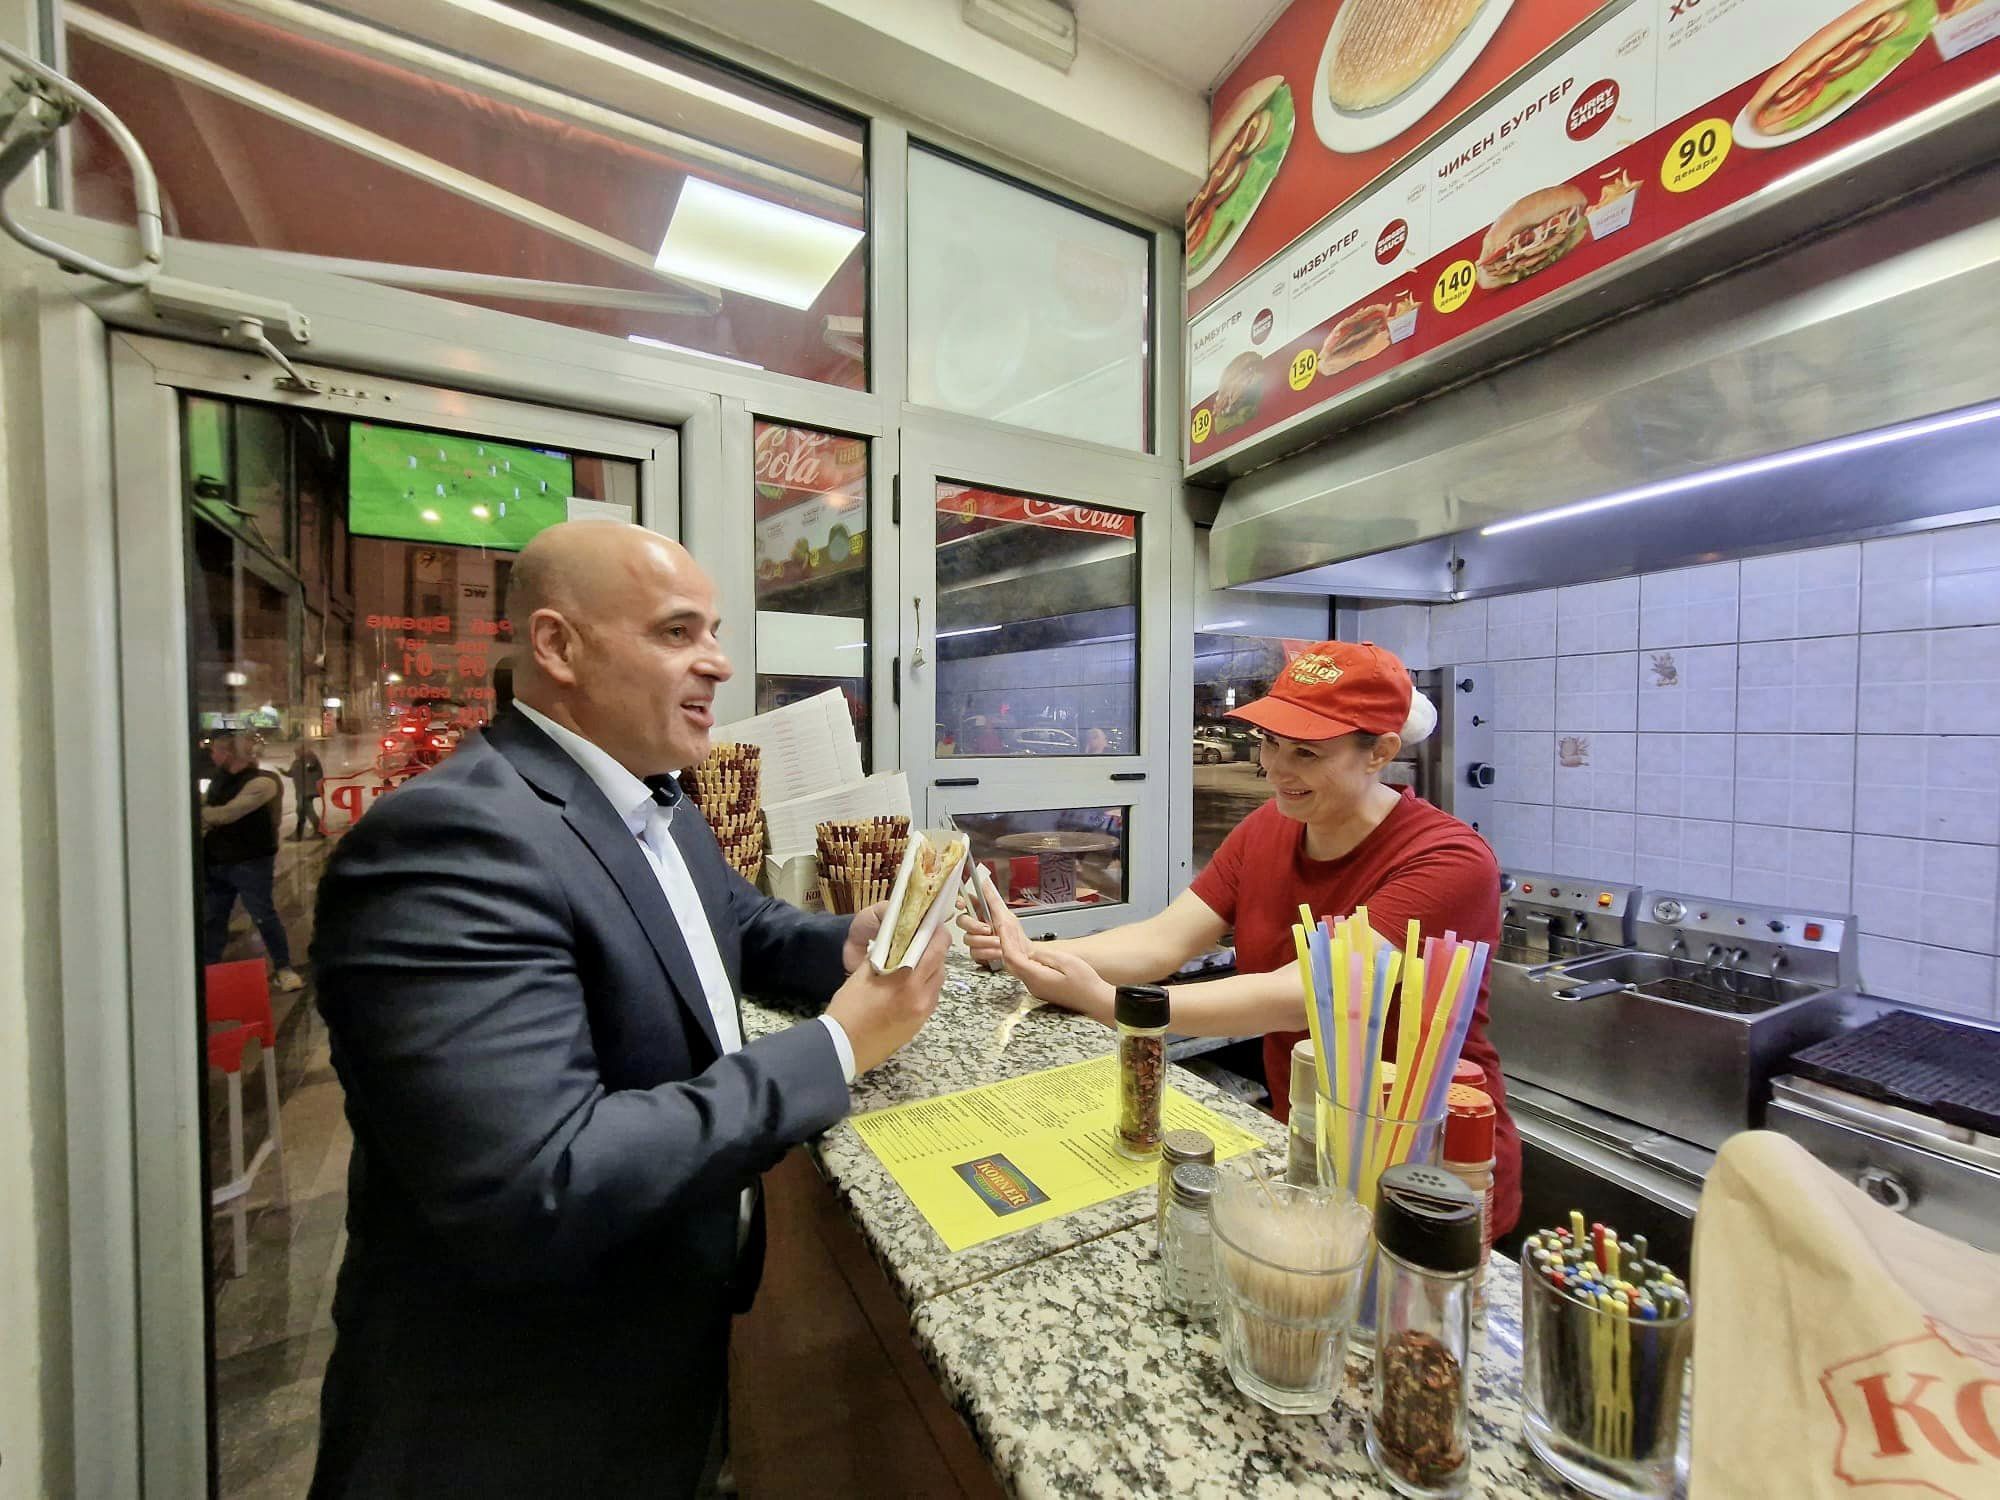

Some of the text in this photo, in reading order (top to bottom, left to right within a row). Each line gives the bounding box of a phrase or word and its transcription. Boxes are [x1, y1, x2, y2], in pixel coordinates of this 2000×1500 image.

[1570, 86, 1615, 120] CURRY
[1570, 96, 1615, 131] SAUCE
[1438, 131, 1494, 179] ЧИКЕН
[1500, 77, 1574, 139] БУРГЕР
[1679, 129, 1716, 169] 90
[1292, 228, 1360, 280] ЧИЗБУРГЕР
[1438, 266, 1471, 298] 140
[1193, 311, 1242, 351] ХАМБУРГЕР
[1292, 354, 1314, 378] 150
[1194, 413, 1209, 433] 130
